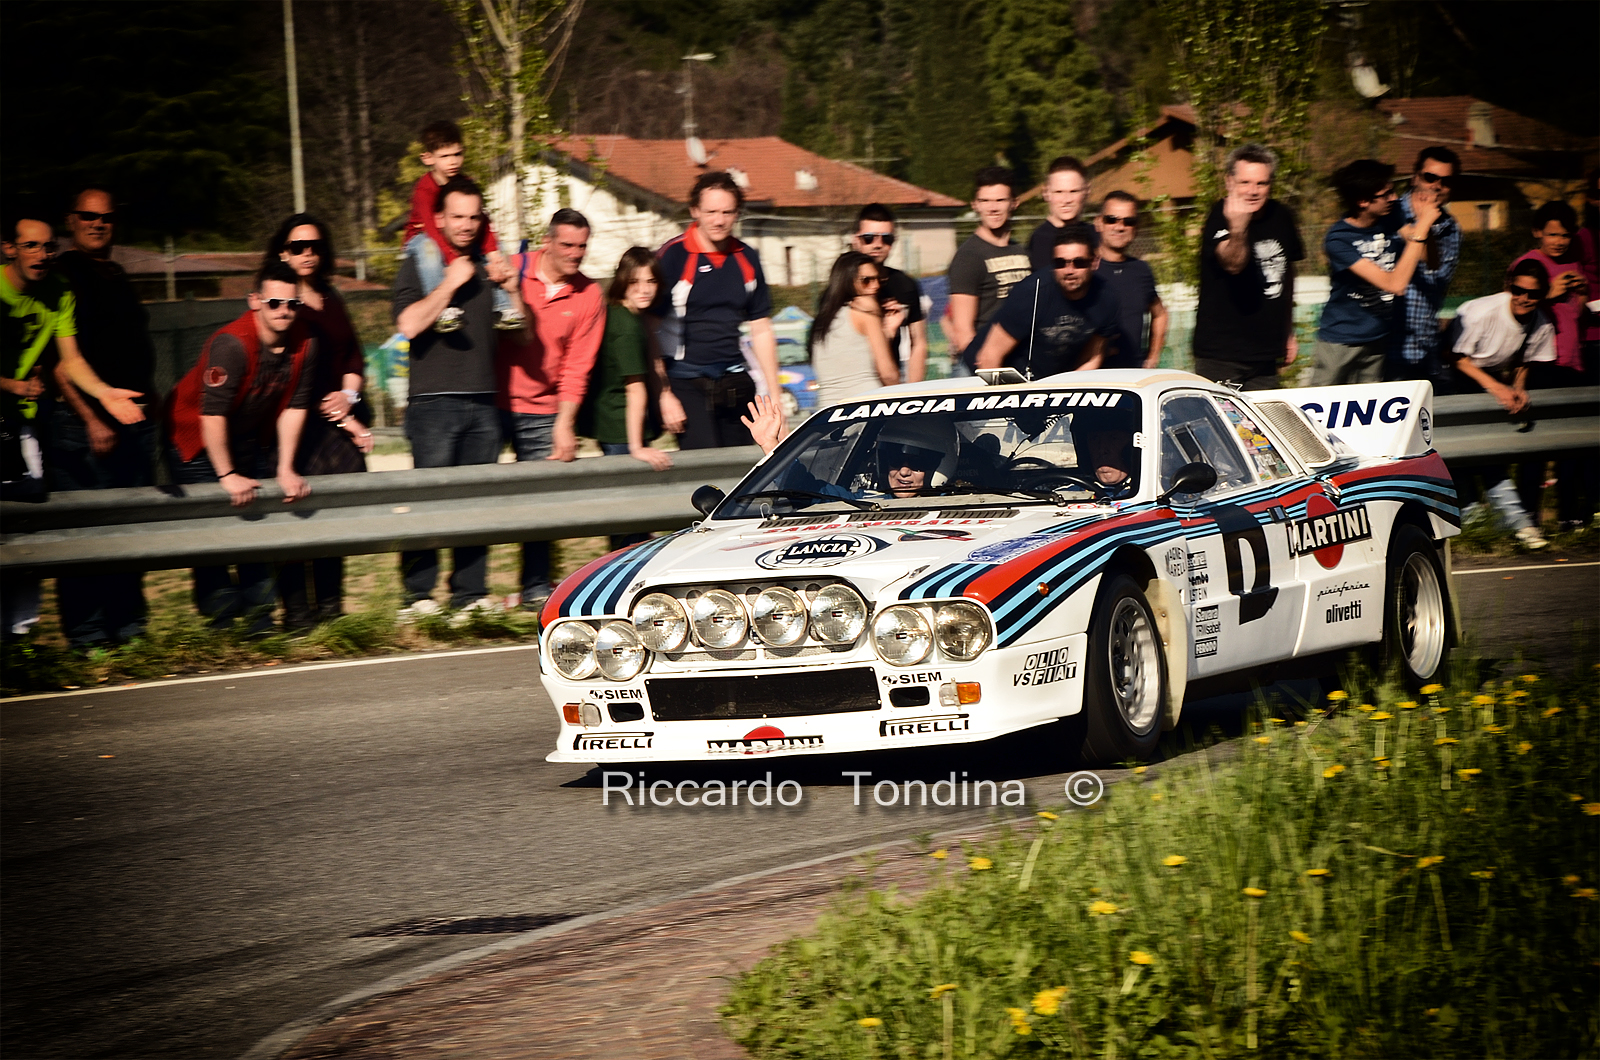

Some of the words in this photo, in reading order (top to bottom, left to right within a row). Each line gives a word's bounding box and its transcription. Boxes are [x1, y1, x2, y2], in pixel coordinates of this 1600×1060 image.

[828, 397, 956, 422] LANCIA
[966, 392, 1122, 411] MARTINI
[1287, 508, 1368, 553] MARTINI
[789, 542, 847, 555] LANCIA
[1326, 600, 1362, 624] olivetti
[1023, 647, 1069, 671] OLIO
[900, 671, 942, 685] SIEM
[1013, 672, 1030, 687] VS
[1031, 662, 1078, 686] FIAT
[604, 689, 643, 700] SIEM
[879, 713, 970, 737] PIRELLI
[572, 731, 654, 751] PIRELLI
